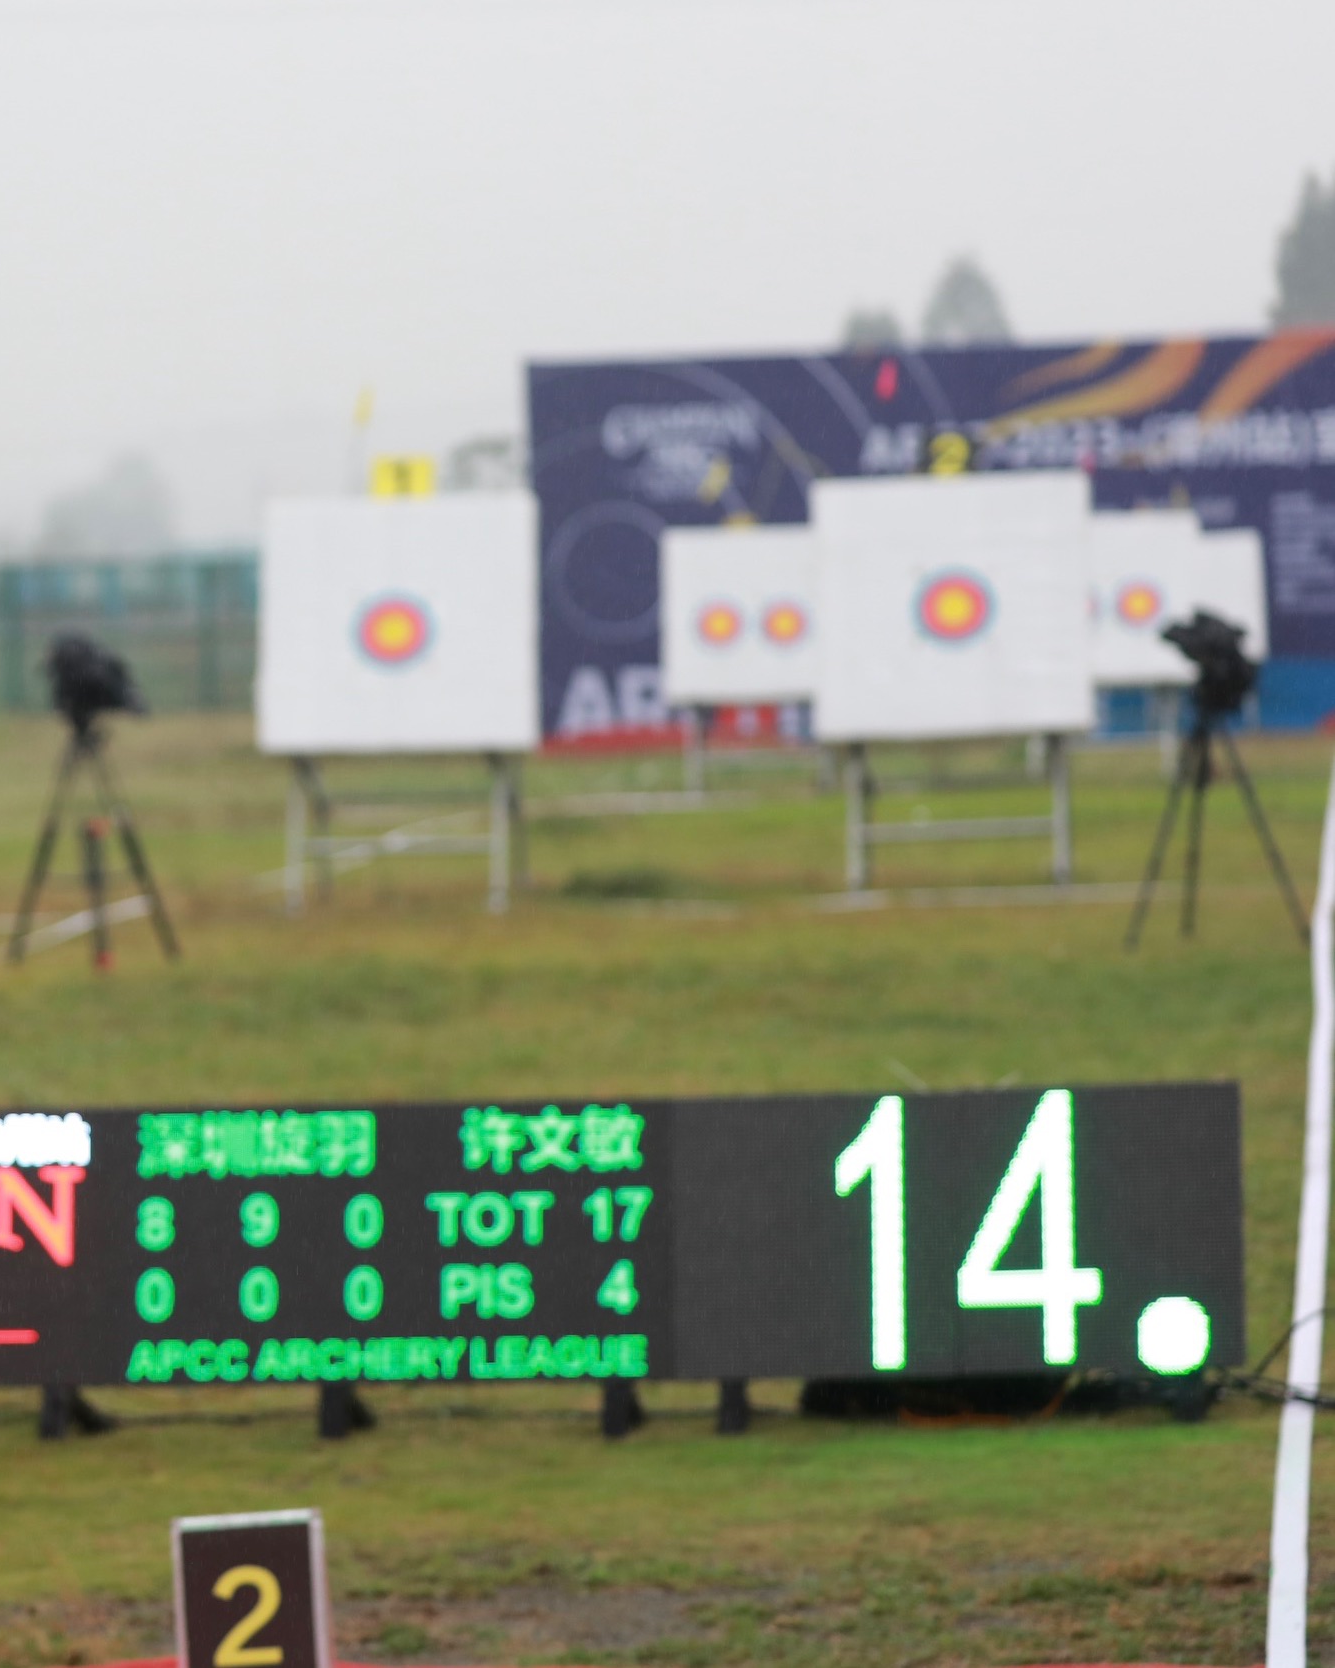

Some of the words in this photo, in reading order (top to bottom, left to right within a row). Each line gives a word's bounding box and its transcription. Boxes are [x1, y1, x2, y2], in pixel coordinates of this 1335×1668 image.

[929, 432, 970, 477] 2
[136, 1196, 176, 1252] 8
[240, 1192, 280, 1248] 9
[344, 1193, 384, 1249] 0
[425, 1190, 555, 1247] TOT
[583, 1186, 654, 1242] 17
[135, 1267, 176, 1323] 0
[239, 1266, 280, 1322] 0
[343, 1265, 384, 1321] 0
[440, 1262, 535, 1319] PIS
[597, 1258, 639, 1315] 4
[127, 1338, 249, 1382] APCC
[253, 1336, 467, 1381] ARCHERY
[469, 1334, 649, 1379] LEAGUE
[212, 1564, 284, 1668] 2
